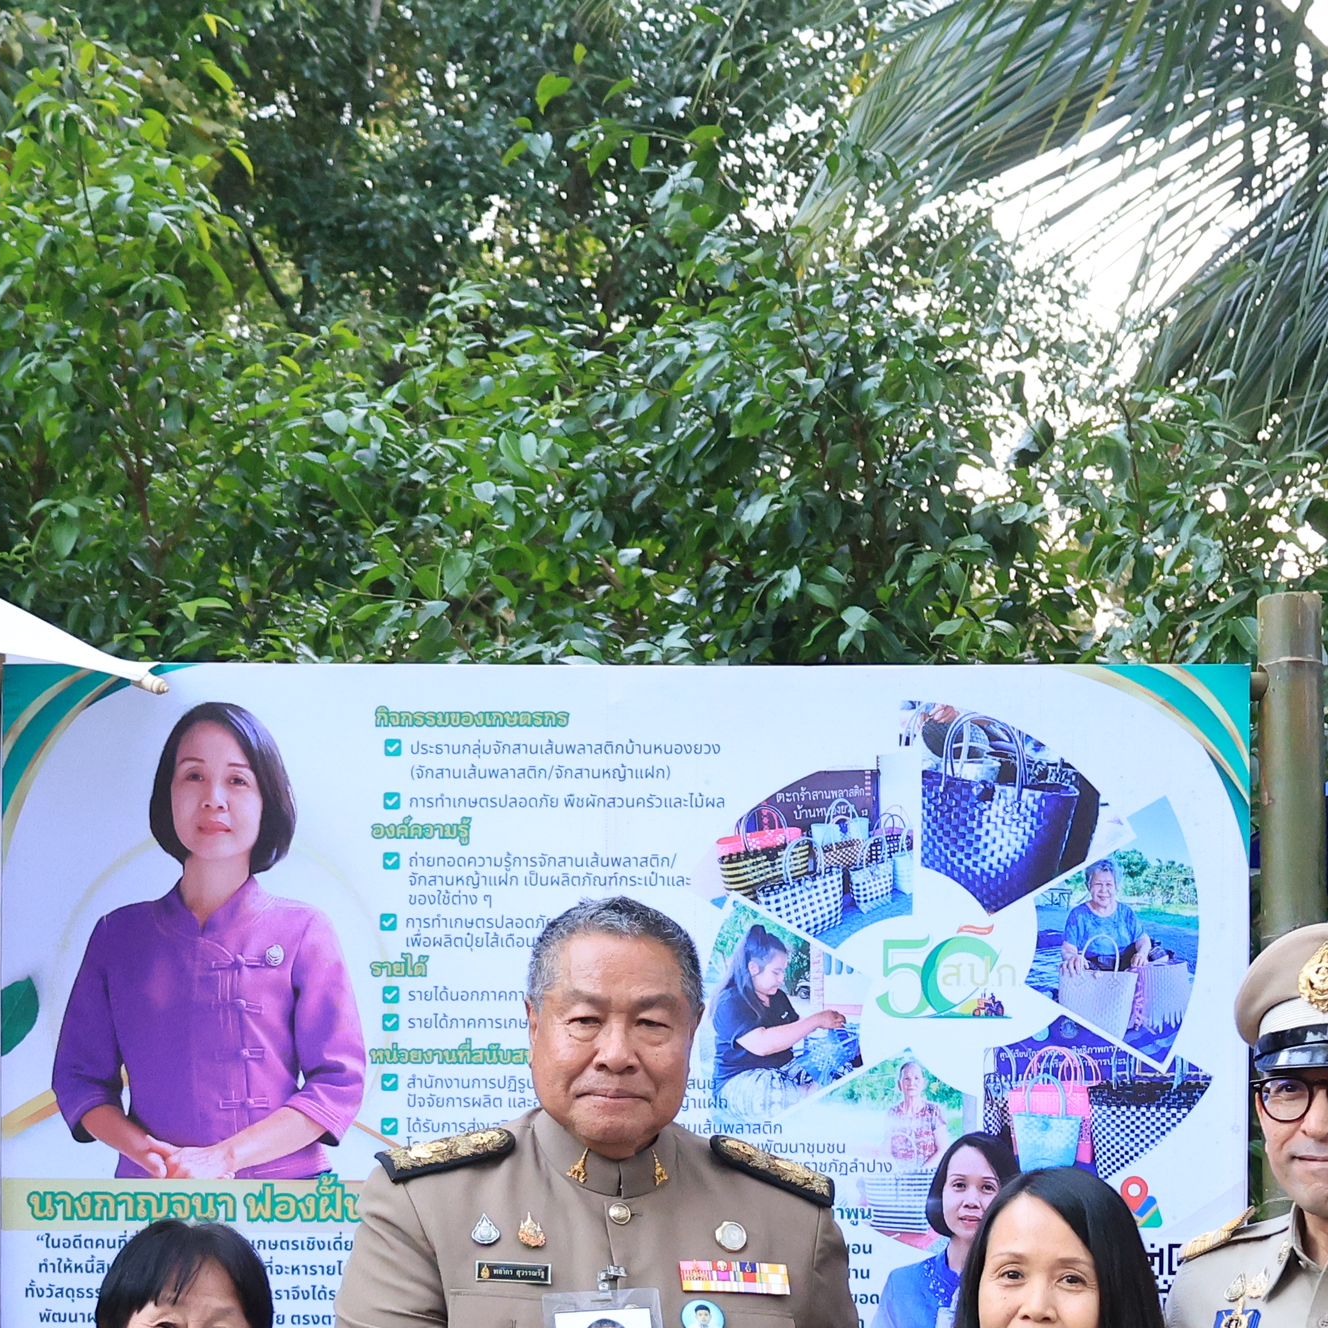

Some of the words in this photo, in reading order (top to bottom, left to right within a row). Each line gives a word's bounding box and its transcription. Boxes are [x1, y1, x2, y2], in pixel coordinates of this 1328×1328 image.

[375, 706, 569, 727] กิจกรรมของเกษตรกร
[409, 793, 559, 809] การทำเกษตรปลอดภัย
[371, 815, 472, 846] องค์ความรู้
[409, 872, 519, 889] จักสานหญ้าแฝก
[409, 892, 480, 907] ของใช้ต่าง
[370, 952, 429, 977] รายได้
[407, 1094, 502, 1108] ปัจจัยการผลิต
